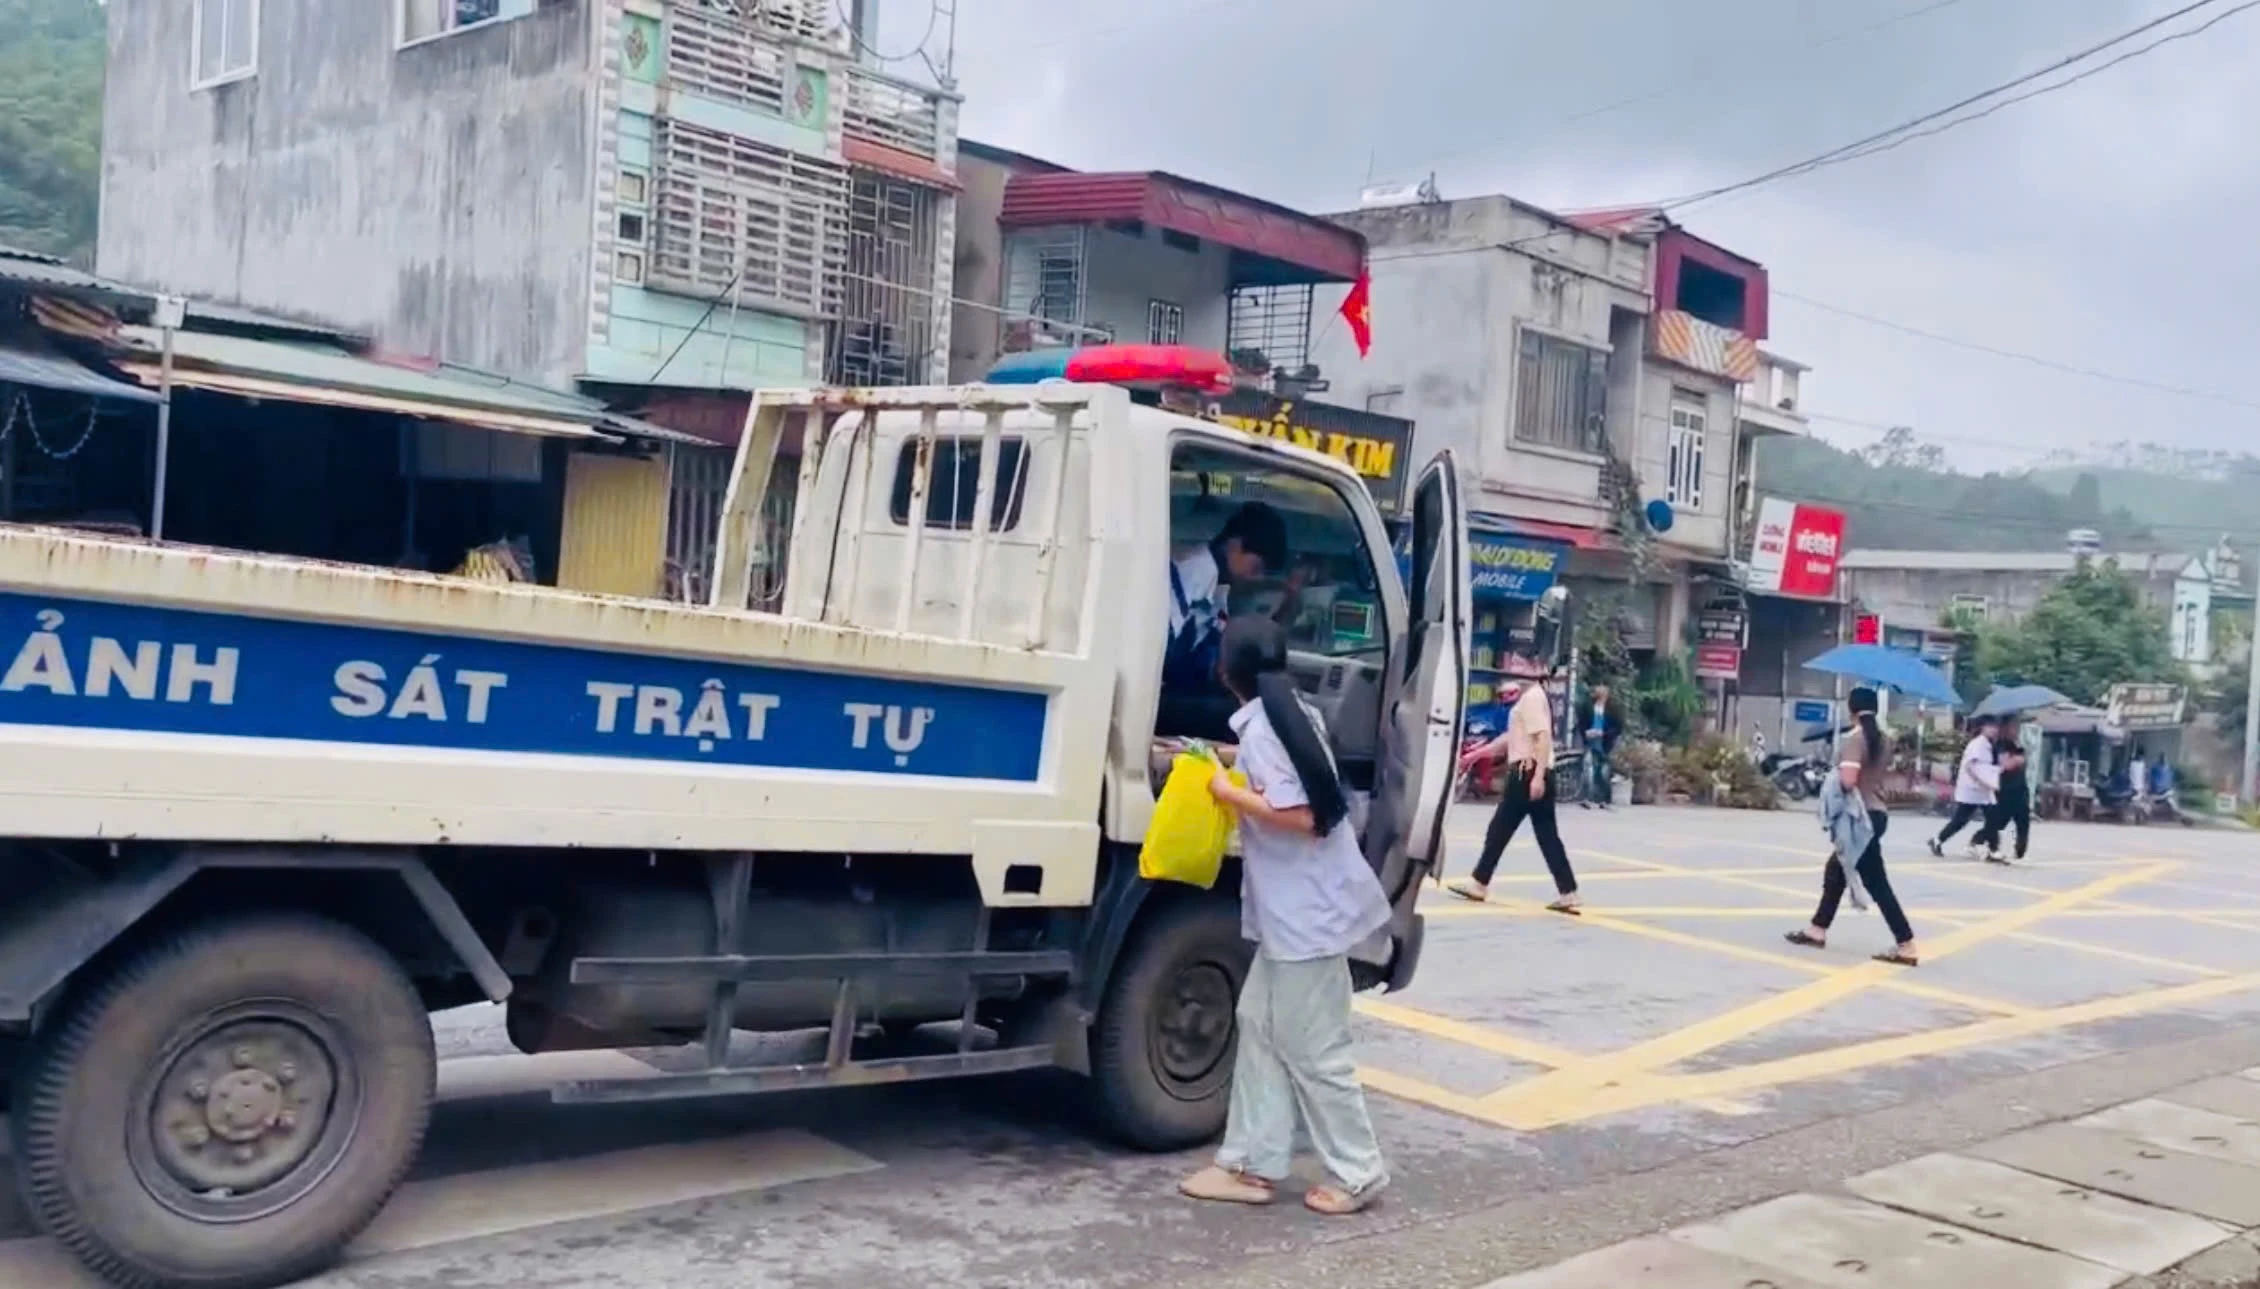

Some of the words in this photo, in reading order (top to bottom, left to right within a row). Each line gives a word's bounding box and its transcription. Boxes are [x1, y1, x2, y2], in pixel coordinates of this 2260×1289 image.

[1328, 433, 1396, 478] KIM
[1472, 571, 1527, 590] MOBILE
[330, 653, 508, 724] SÁT
[586, 678, 780, 753] TRẬT
[844, 702, 935, 767] TỰ
